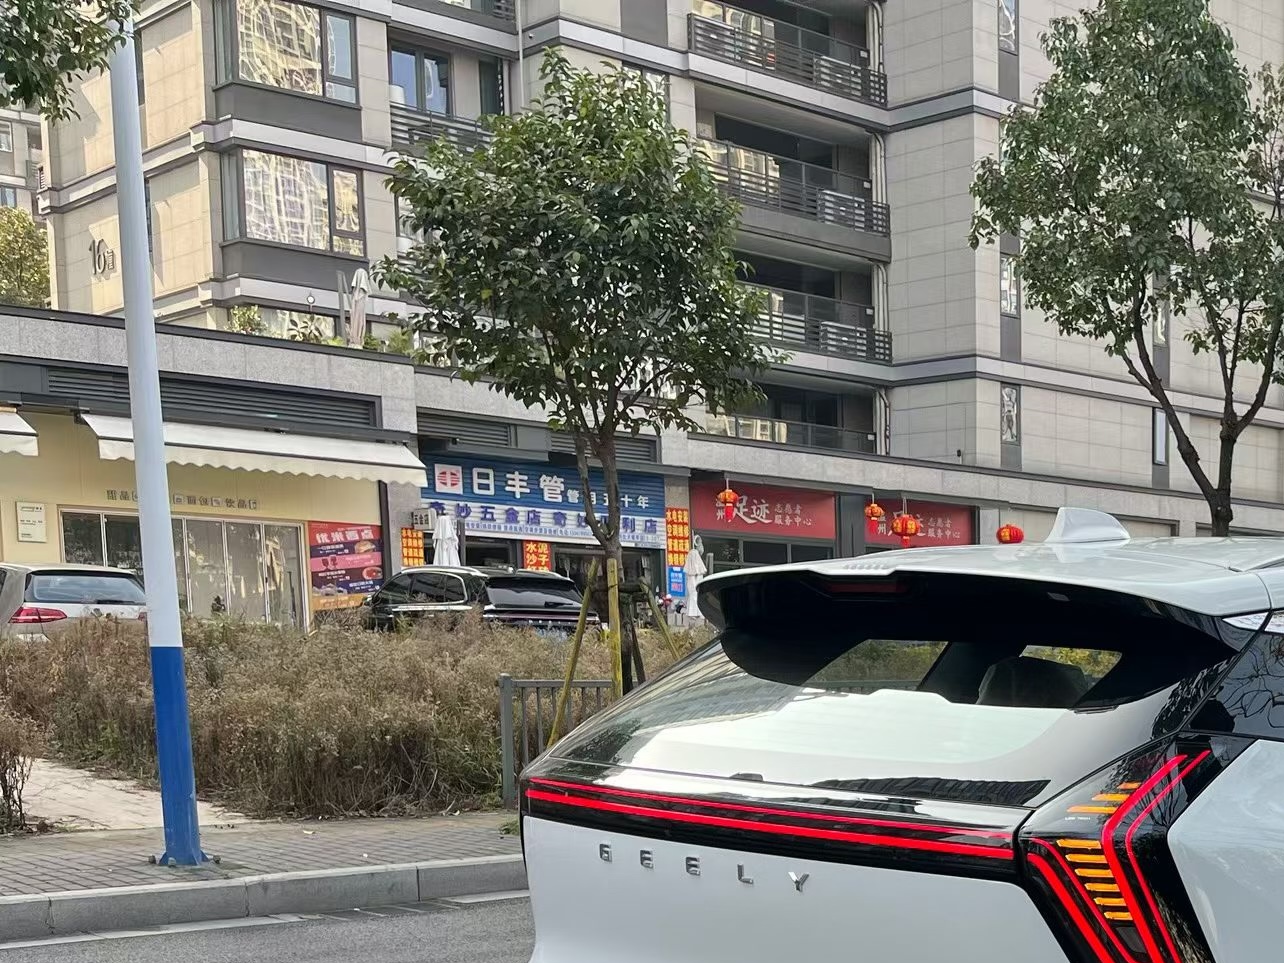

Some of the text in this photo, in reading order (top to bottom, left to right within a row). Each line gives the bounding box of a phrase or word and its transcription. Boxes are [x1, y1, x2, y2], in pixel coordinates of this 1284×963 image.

[472, 467, 565, 503] 日丰管
[733, 495, 773, 524] 足迹
[774, 514, 812, 526] 服务中心
[525, 541, 549, 554] 水泥
[599, 842, 810, 893] GEELY
